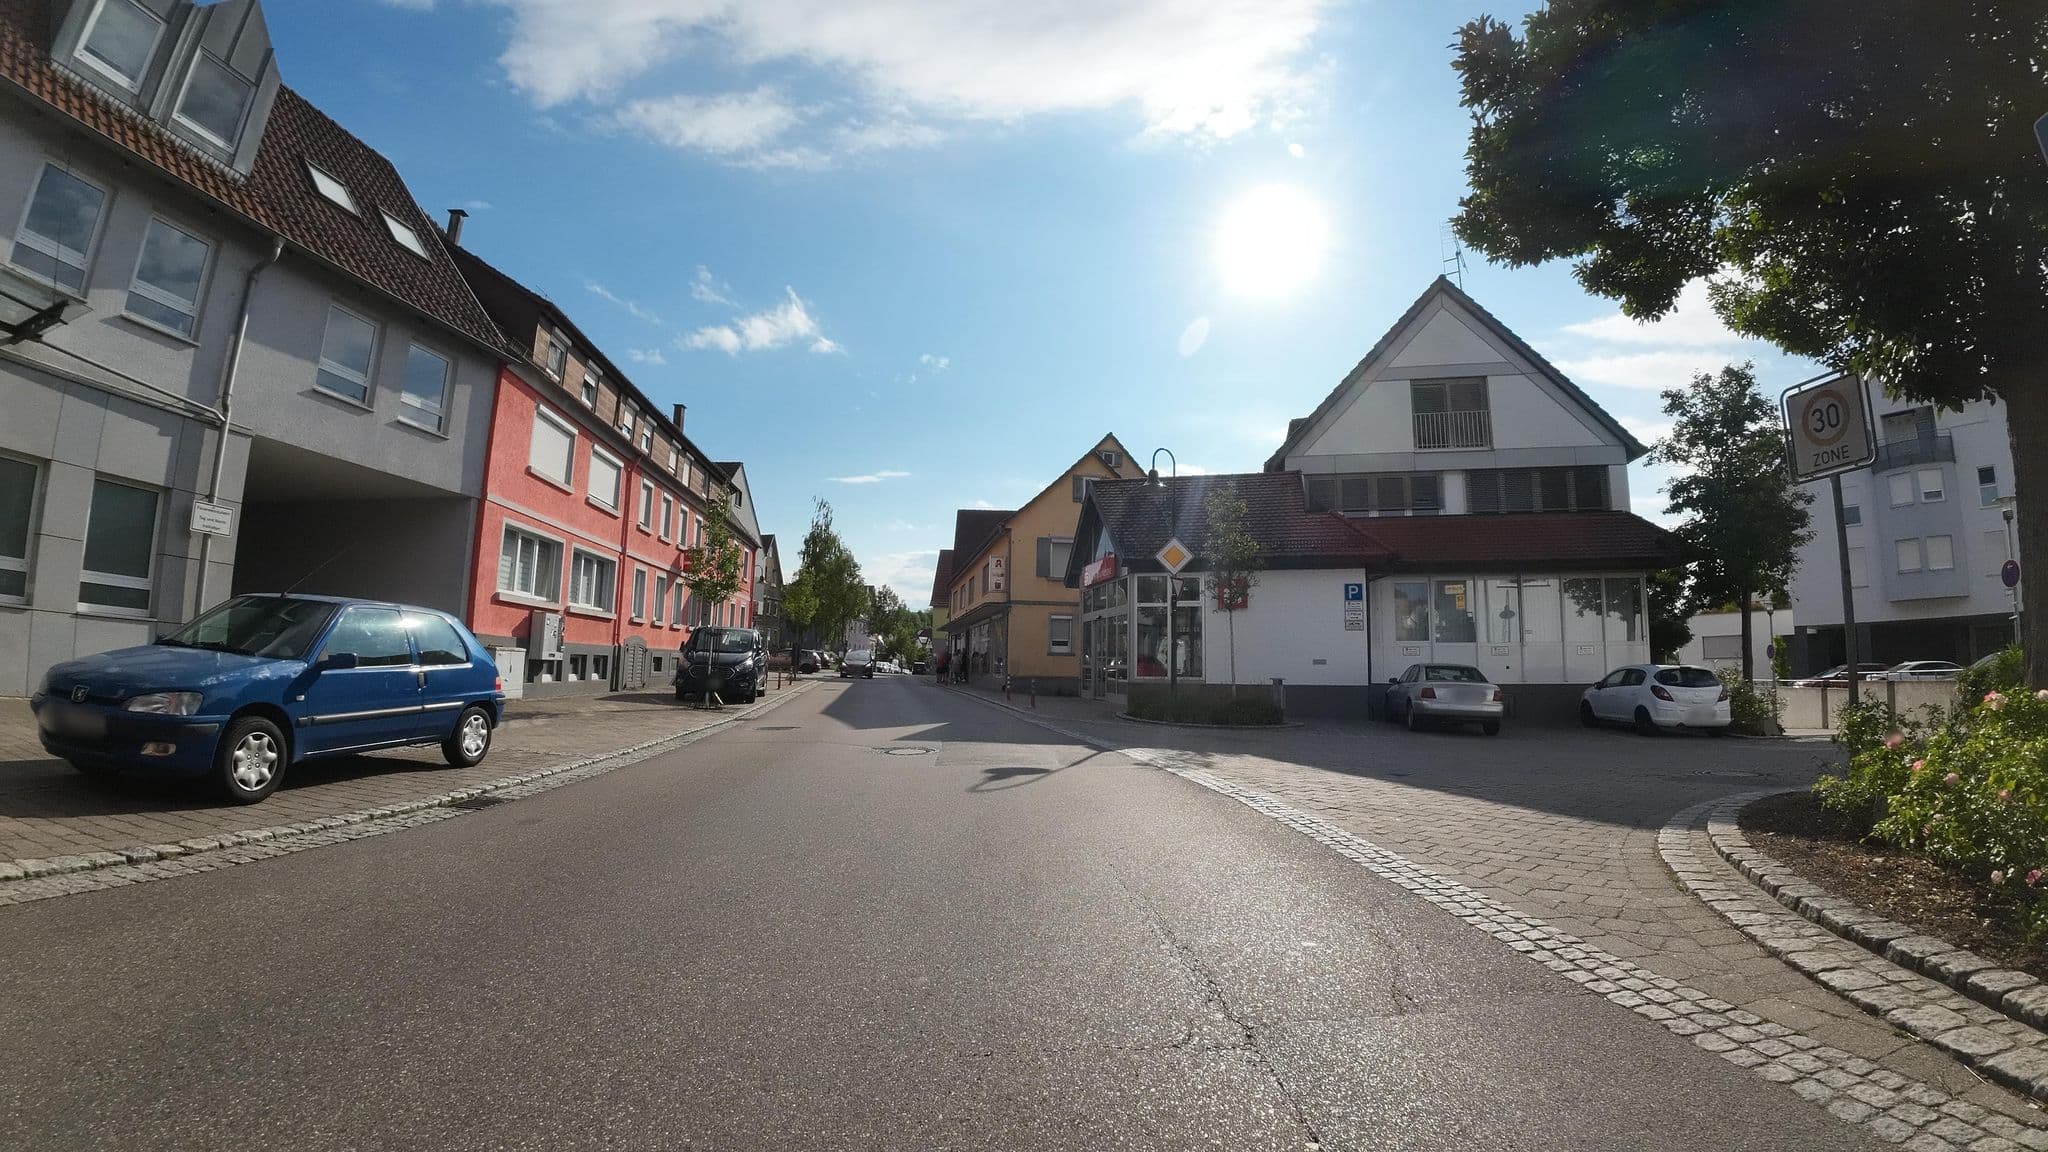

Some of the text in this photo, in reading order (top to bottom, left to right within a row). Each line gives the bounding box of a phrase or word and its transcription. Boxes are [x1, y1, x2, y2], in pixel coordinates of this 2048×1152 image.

[1812, 403, 1840, 433] 30
[1813, 445, 1850, 467] ZONE
[1348, 585, 1359, 599] P
